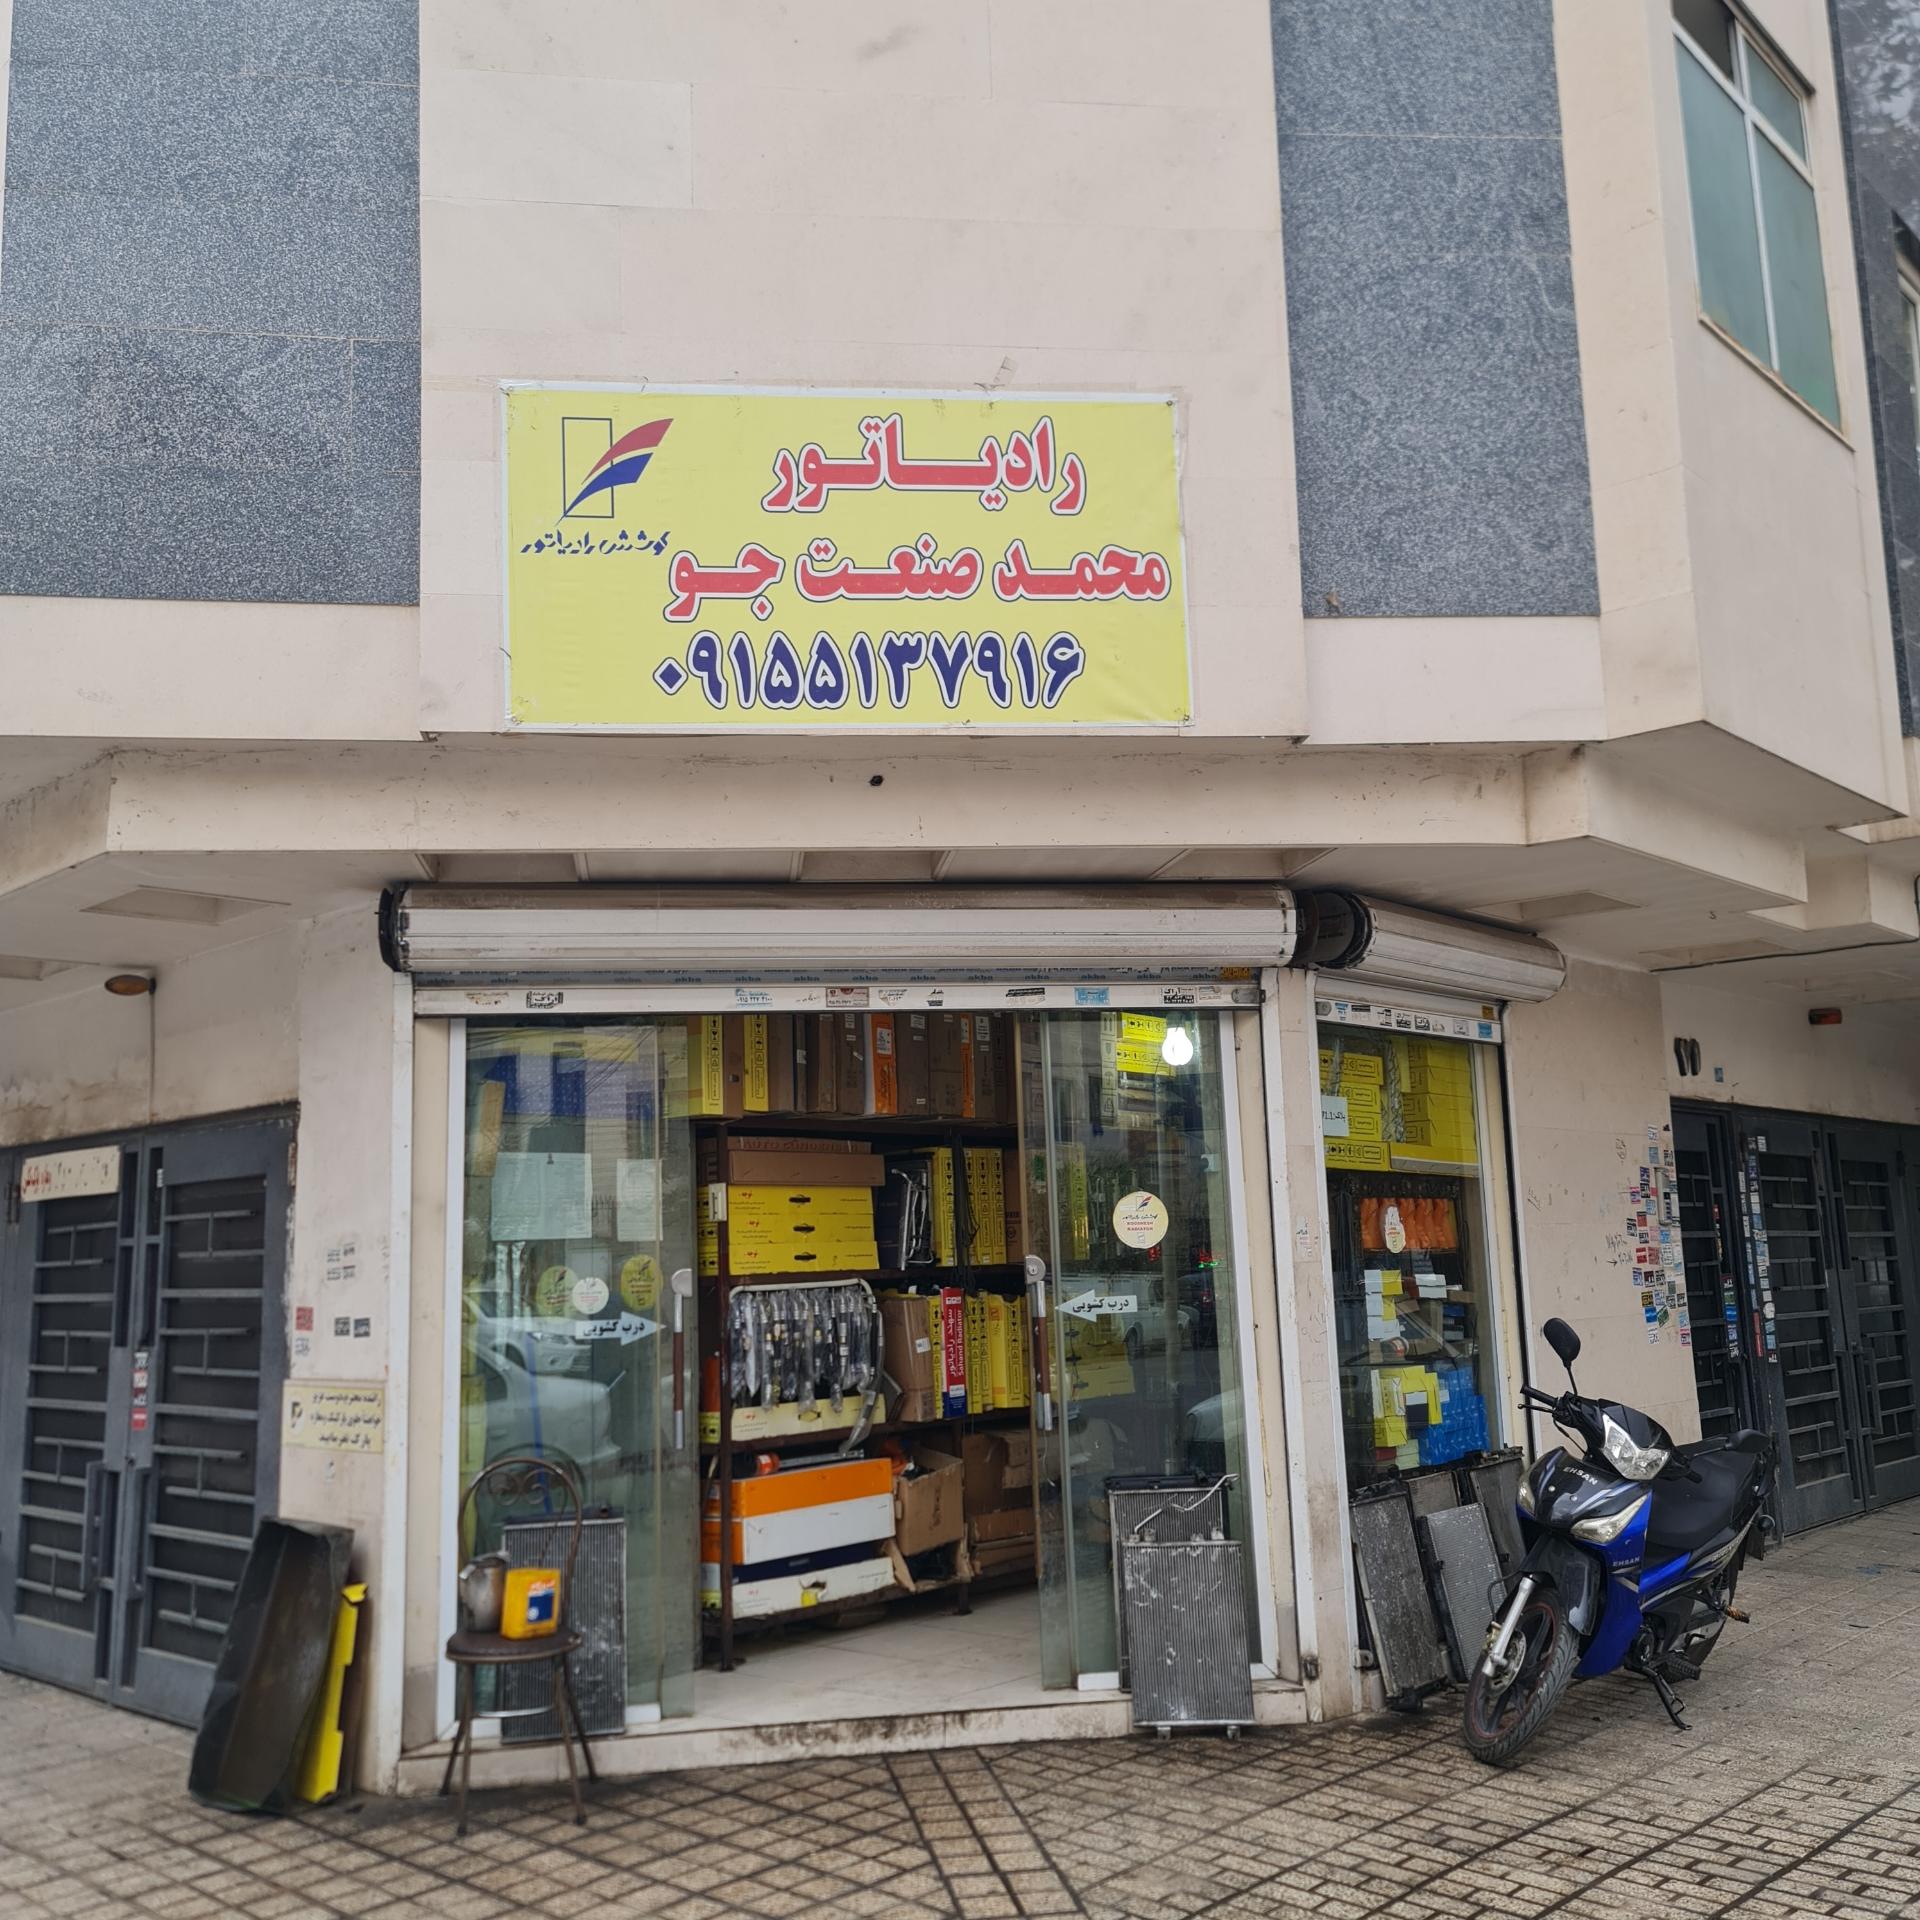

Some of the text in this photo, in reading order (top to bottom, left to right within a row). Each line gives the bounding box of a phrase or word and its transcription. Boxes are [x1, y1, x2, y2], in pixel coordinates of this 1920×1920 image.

[763, 412, 1086, 515] رادیاتور
[520, 529, 671, 555] کوشش رادیاتور
[663, 532, 1171, 622] محمد صنعت جو
[653, 630, 1085, 710] ۰۹۱۵۵۱۳۷۹۱۶
[622, 1321, 645, 1335] درب
[1563, 1466, 1598, 1486] EHSAN
[1612, 1556, 1640, 1568] EHSAN
